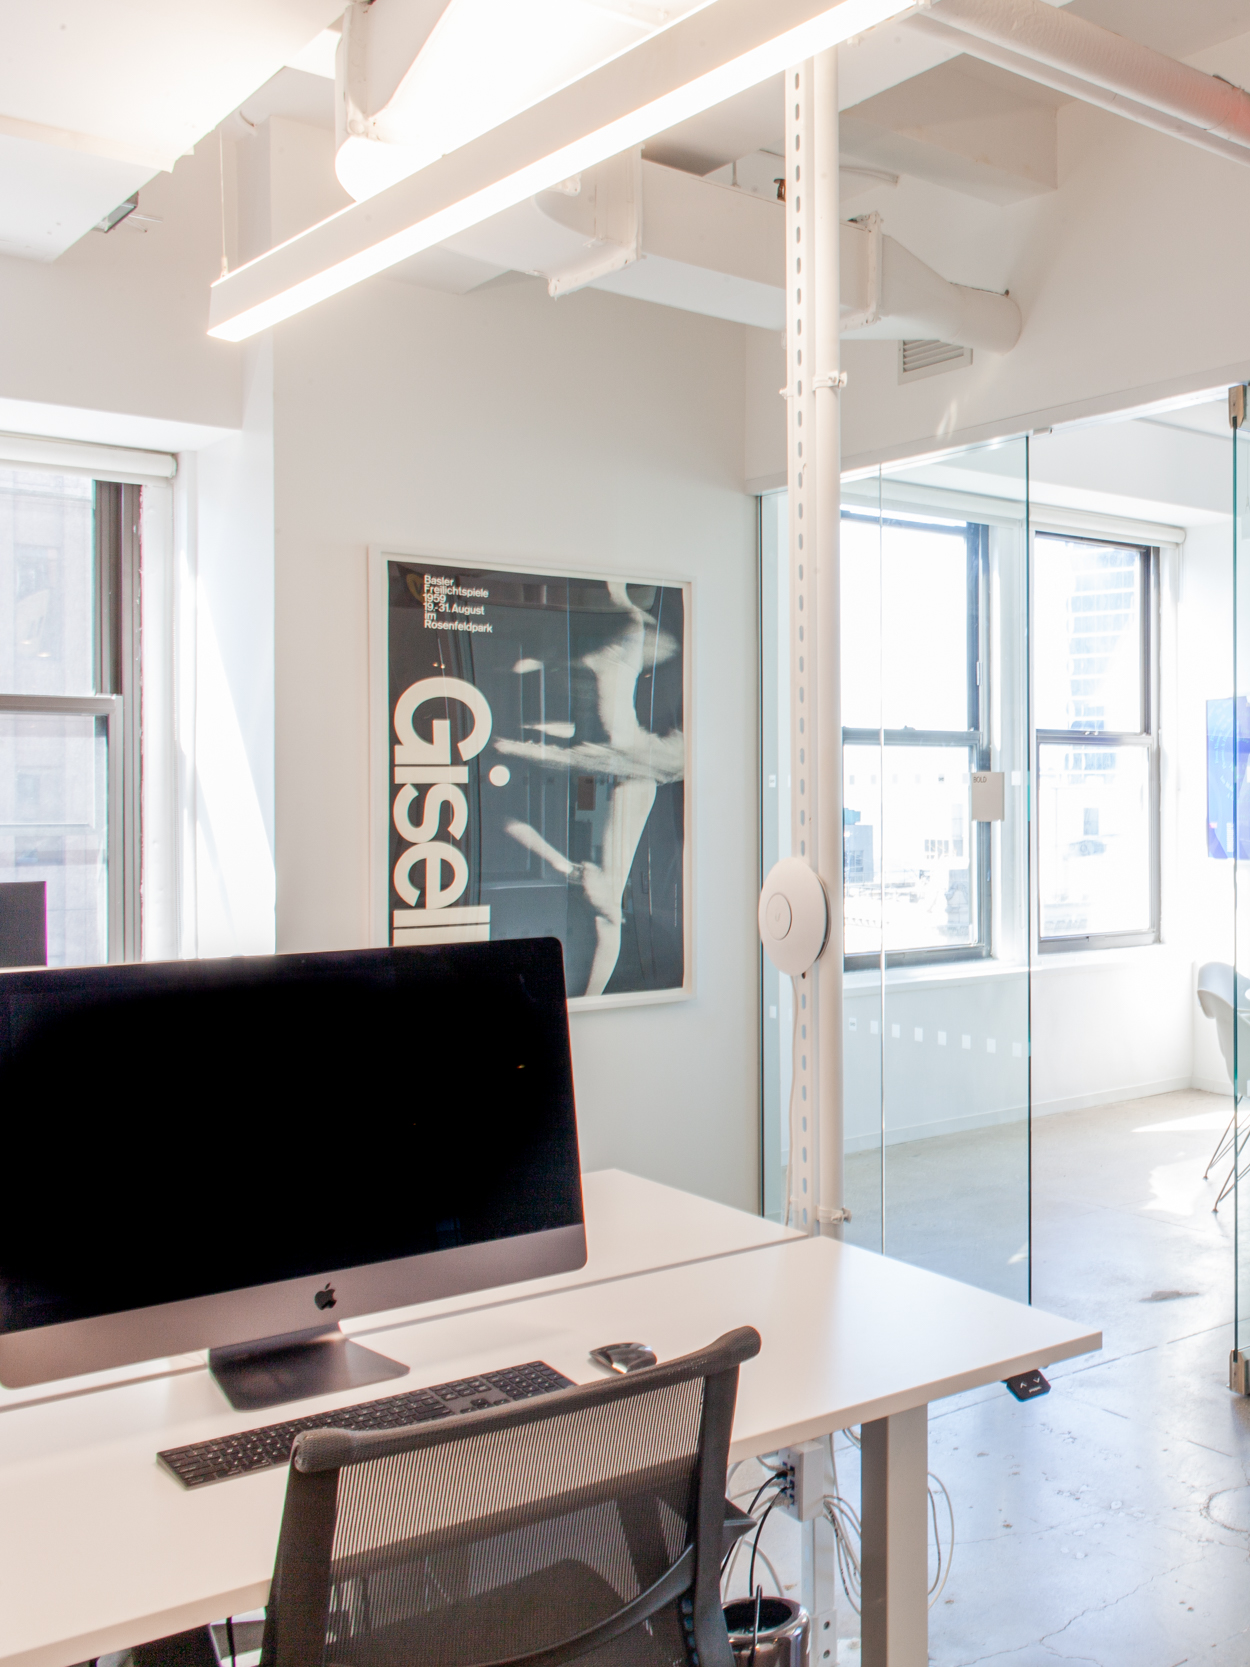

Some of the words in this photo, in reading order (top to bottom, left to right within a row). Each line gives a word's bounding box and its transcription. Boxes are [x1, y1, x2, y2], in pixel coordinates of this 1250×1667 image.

[424, 574, 454, 586] Basler
[424, 585, 489, 598] Freilichtspiele
[422, 594, 446, 603] 1959
[424, 611, 437, 620] im
[452, 603, 485, 616] August
[424, 620, 493, 634] Rosenfeldpark
[393, 676, 511, 947] Gisell
